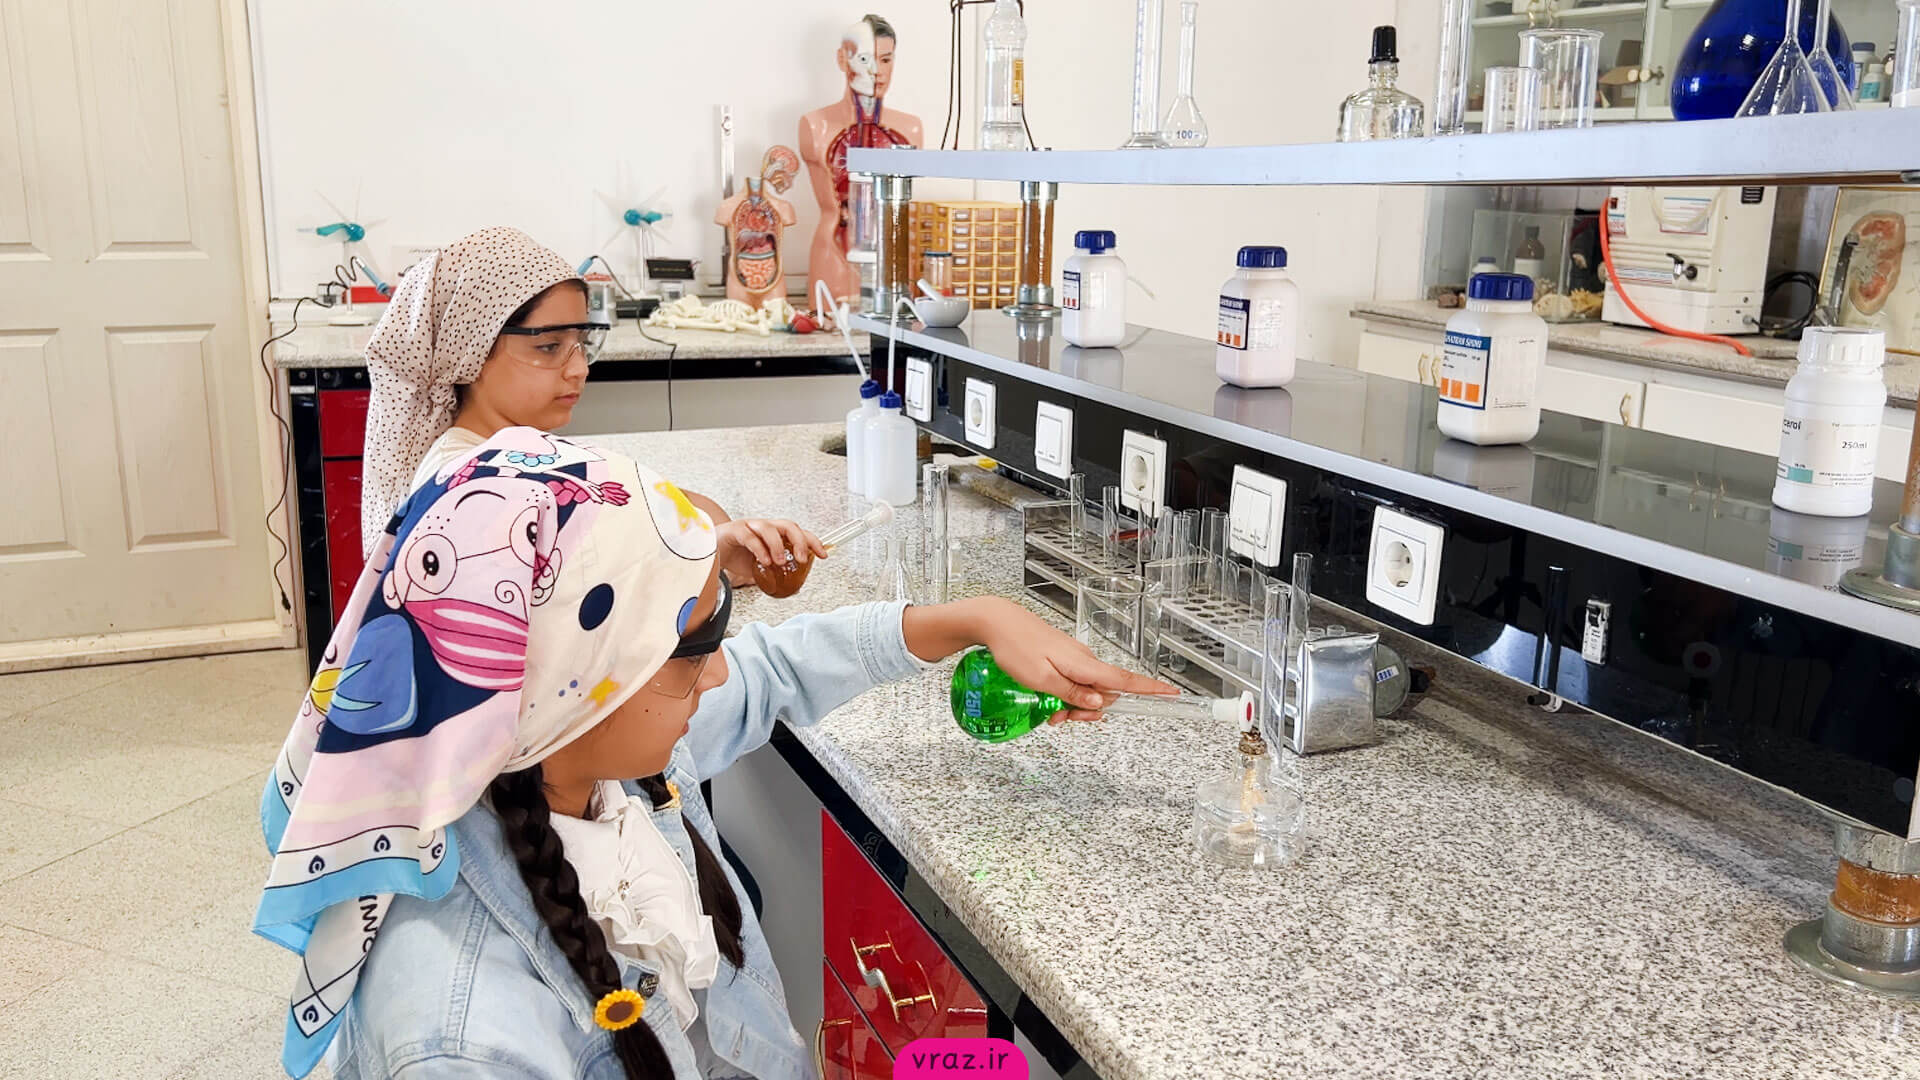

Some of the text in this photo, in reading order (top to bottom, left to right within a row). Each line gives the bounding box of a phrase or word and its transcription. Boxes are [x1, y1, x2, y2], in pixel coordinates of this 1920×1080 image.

[1177, 130, 1193, 139] 100
[1841, 440, 1868, 449] 250ml
[965, 690, 982, 718] 250
